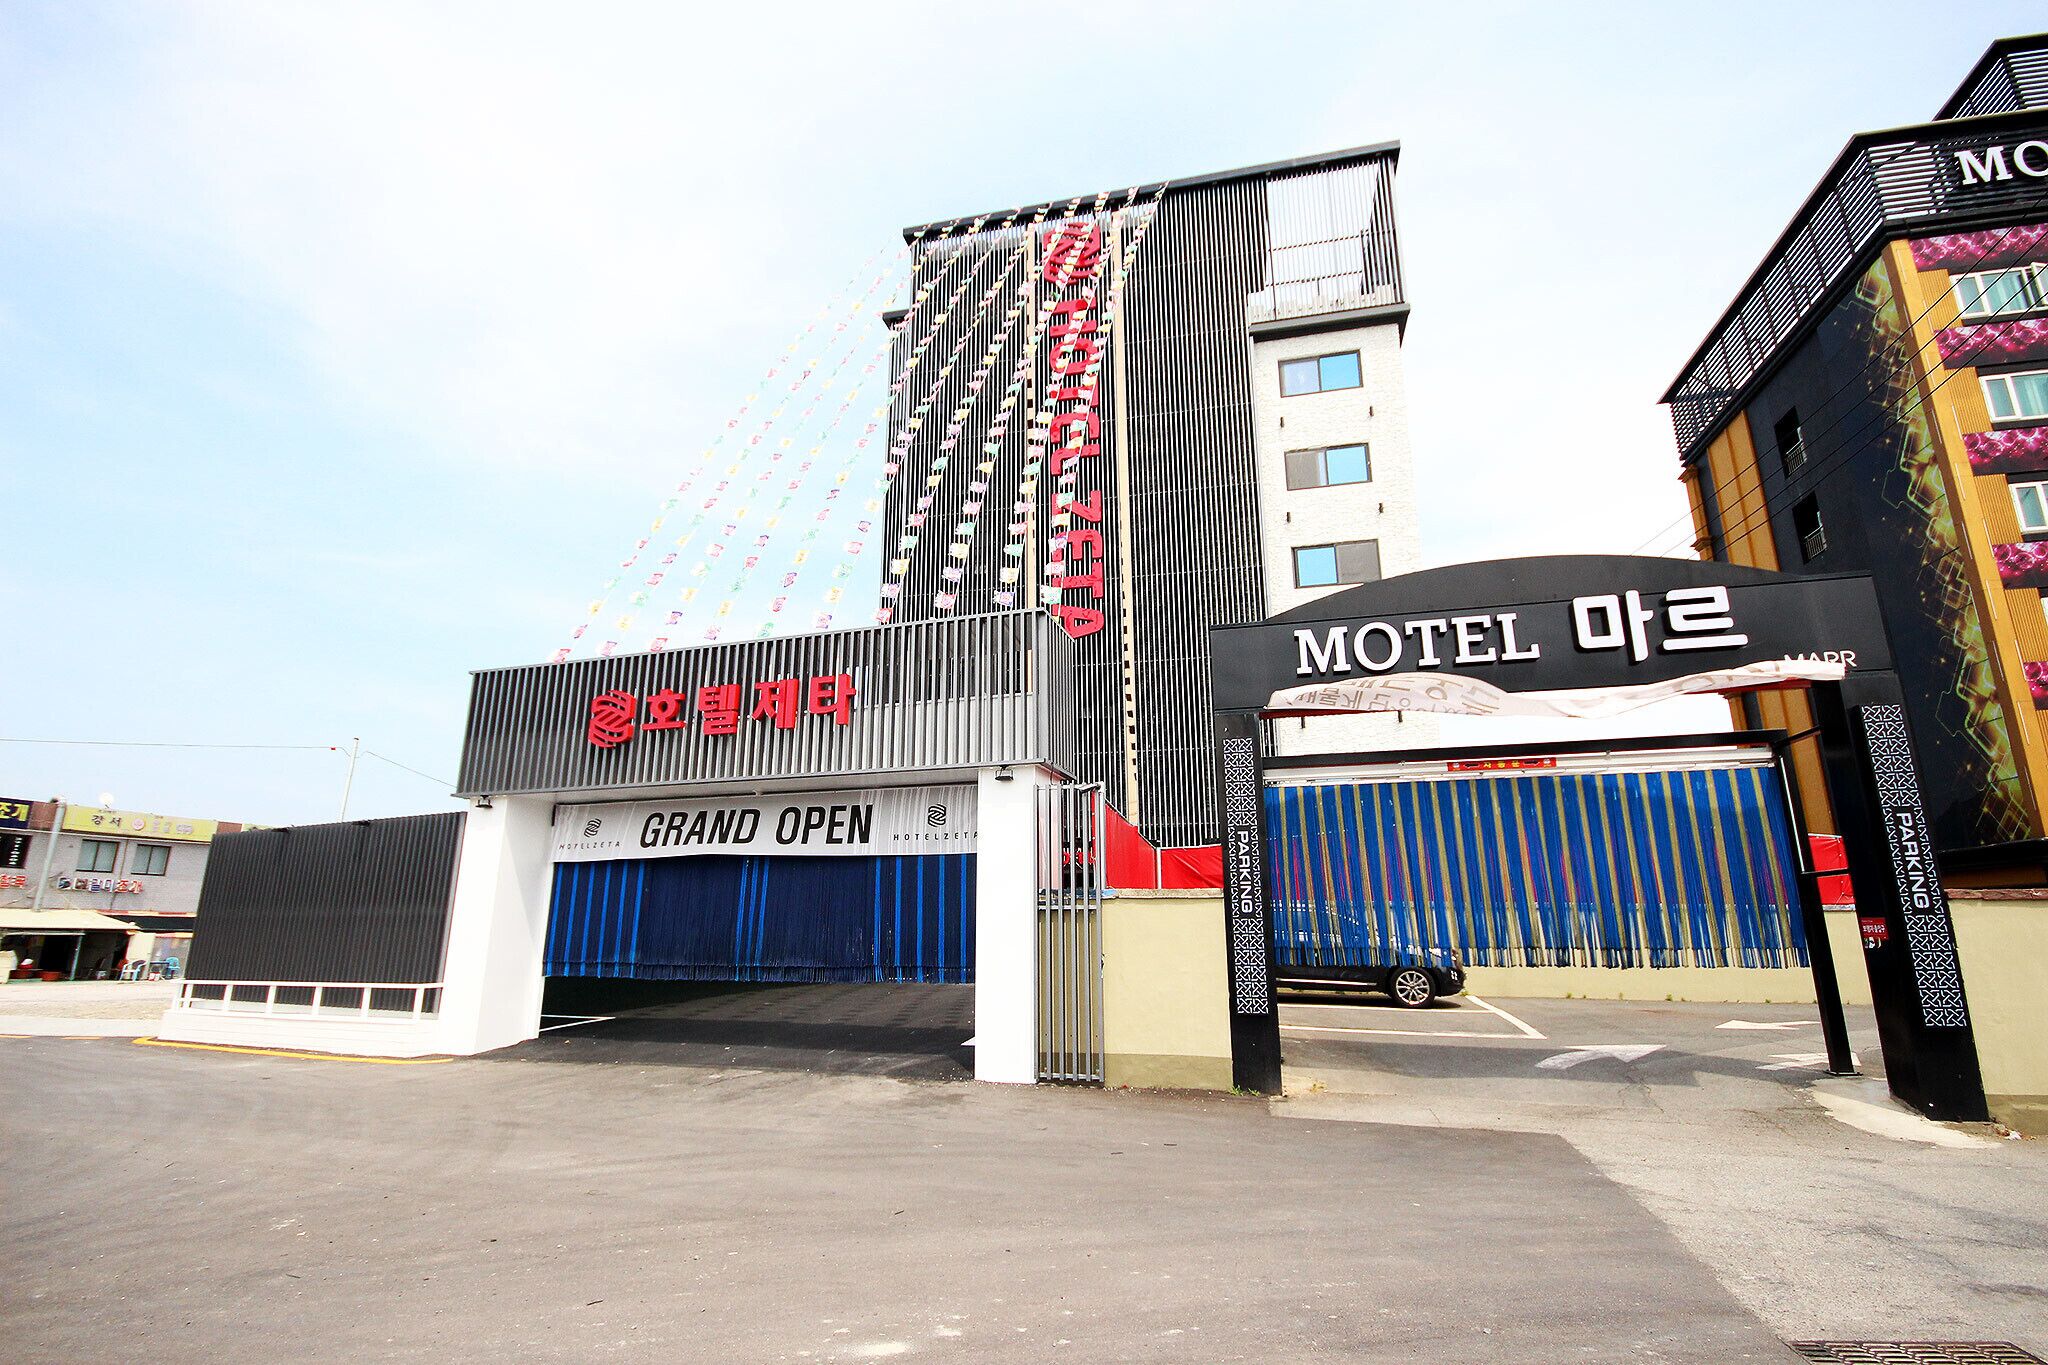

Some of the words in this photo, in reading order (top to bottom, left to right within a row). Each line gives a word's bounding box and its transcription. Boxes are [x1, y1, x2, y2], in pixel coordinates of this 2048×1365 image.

[1953, 140, 2048, 185] MO
[1050, 297, 1099, 476] HOTEL
[1051, 490, 1105, 639] ZETA
[1294, 612, 1541, 675] MOTEL
[1572, 586, 1749, 662] 마르
[641, 673, 857, 736] 호텔제타
[640, 808, 761, 849] GRAND
[776, 804, 874, 846] OPEN
[1896, 813, 1930, 909] PARKING
[1237, 831, 1253, 914] PARKING
